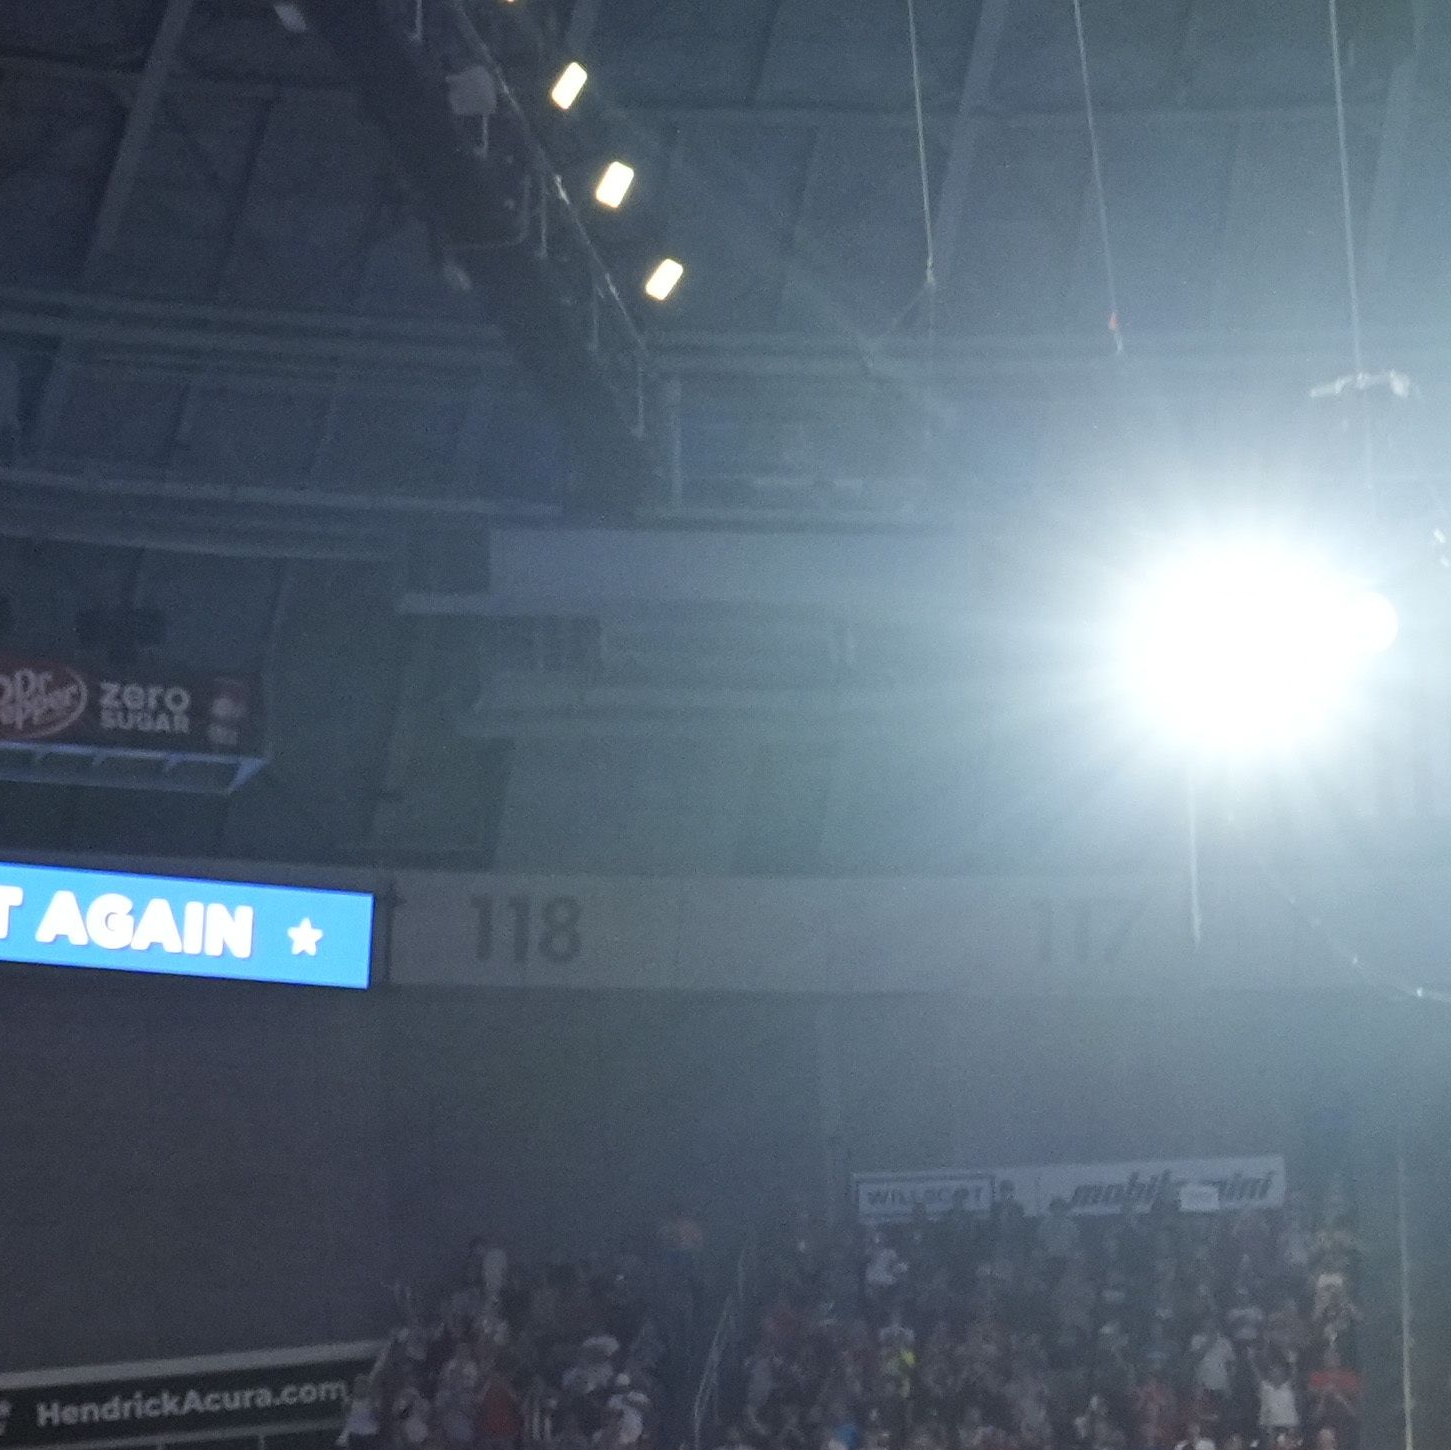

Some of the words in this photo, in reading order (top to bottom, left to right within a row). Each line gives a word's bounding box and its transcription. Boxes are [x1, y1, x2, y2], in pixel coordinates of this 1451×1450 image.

[99, 681, 192, 714] zero
[100, 708, 190, 735] SUGAR
[35, 889, 254, 959] AGAIN
[469, 895, 582, 964] 118
[35, 1379, 347, 1428] HendrickAcura.com
